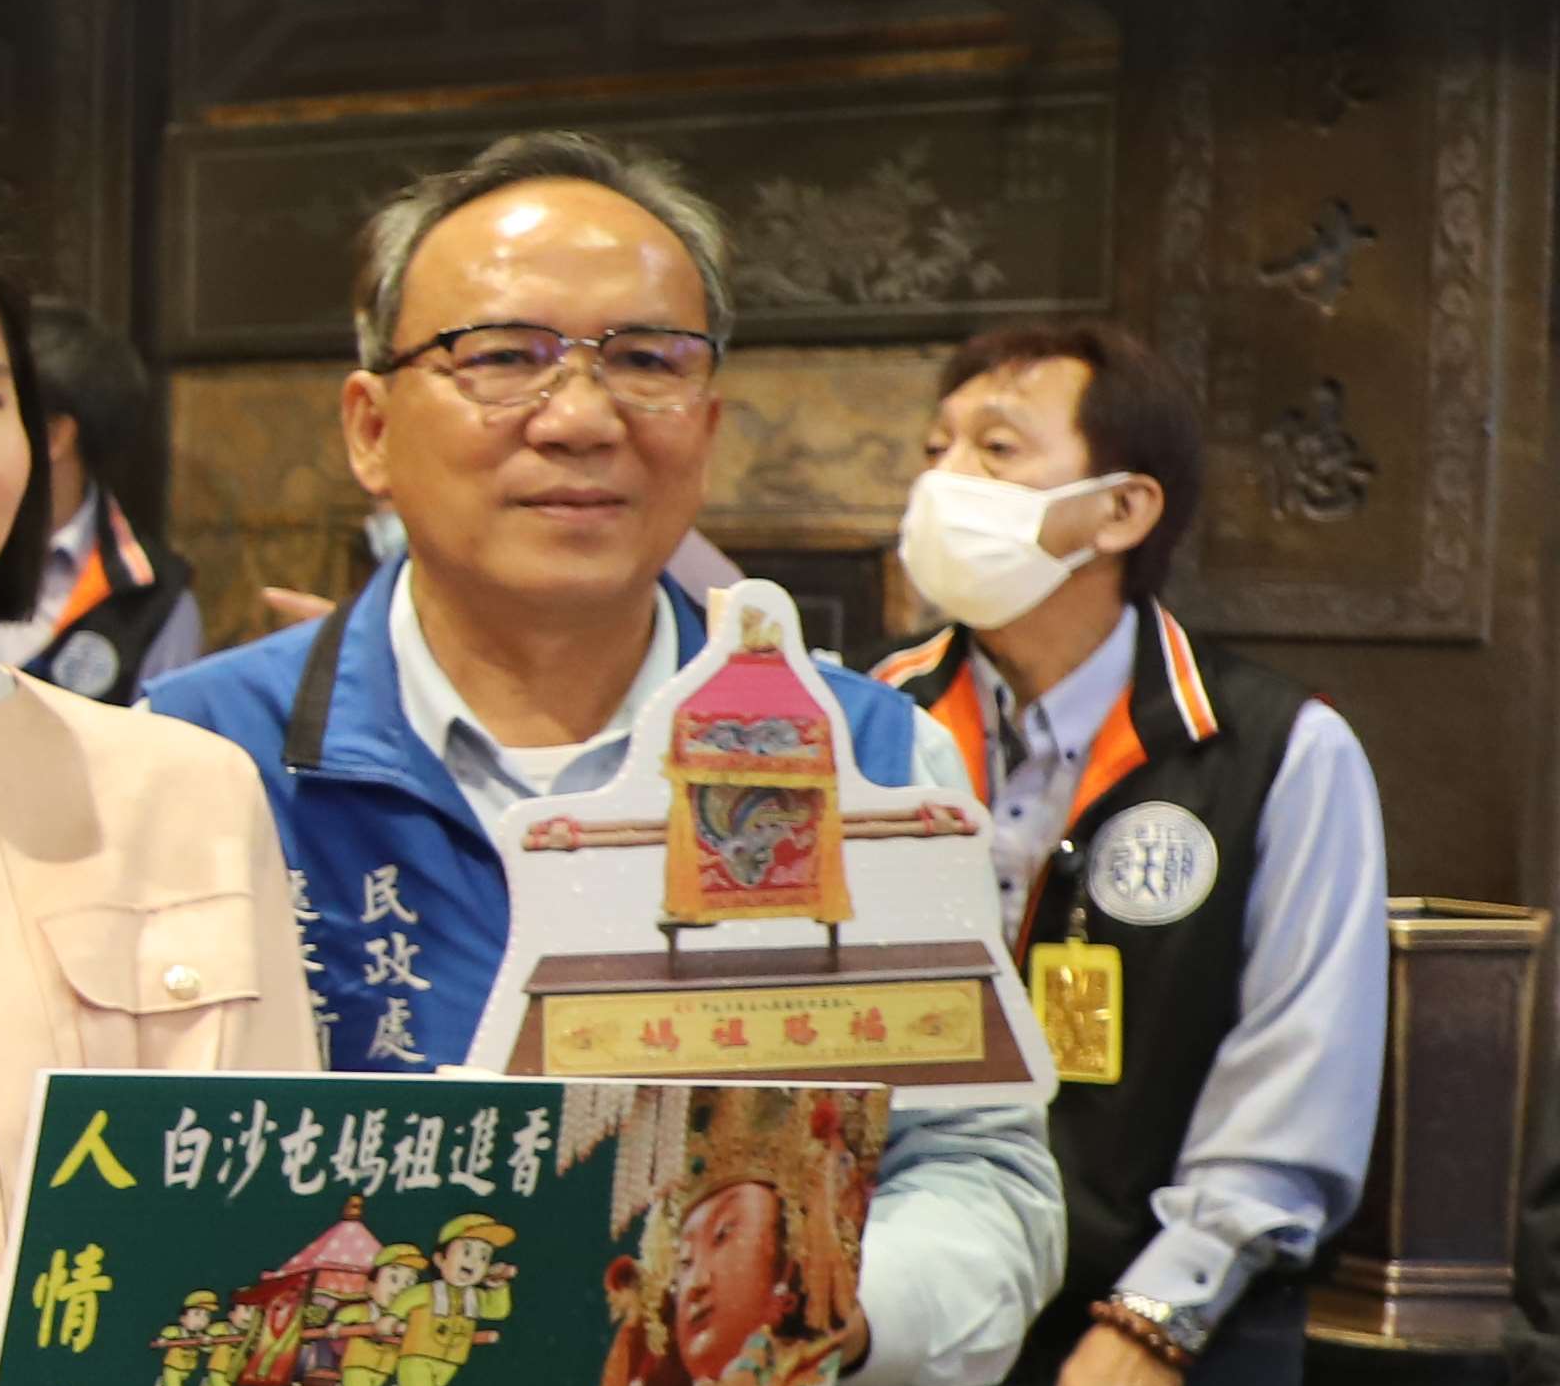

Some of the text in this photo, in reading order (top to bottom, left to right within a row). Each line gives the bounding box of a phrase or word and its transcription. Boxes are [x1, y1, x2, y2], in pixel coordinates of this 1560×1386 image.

[361, 865, 430, 1062] 民政處
[165, 1098, 553, 1201] 白沙屯媽祖進香
